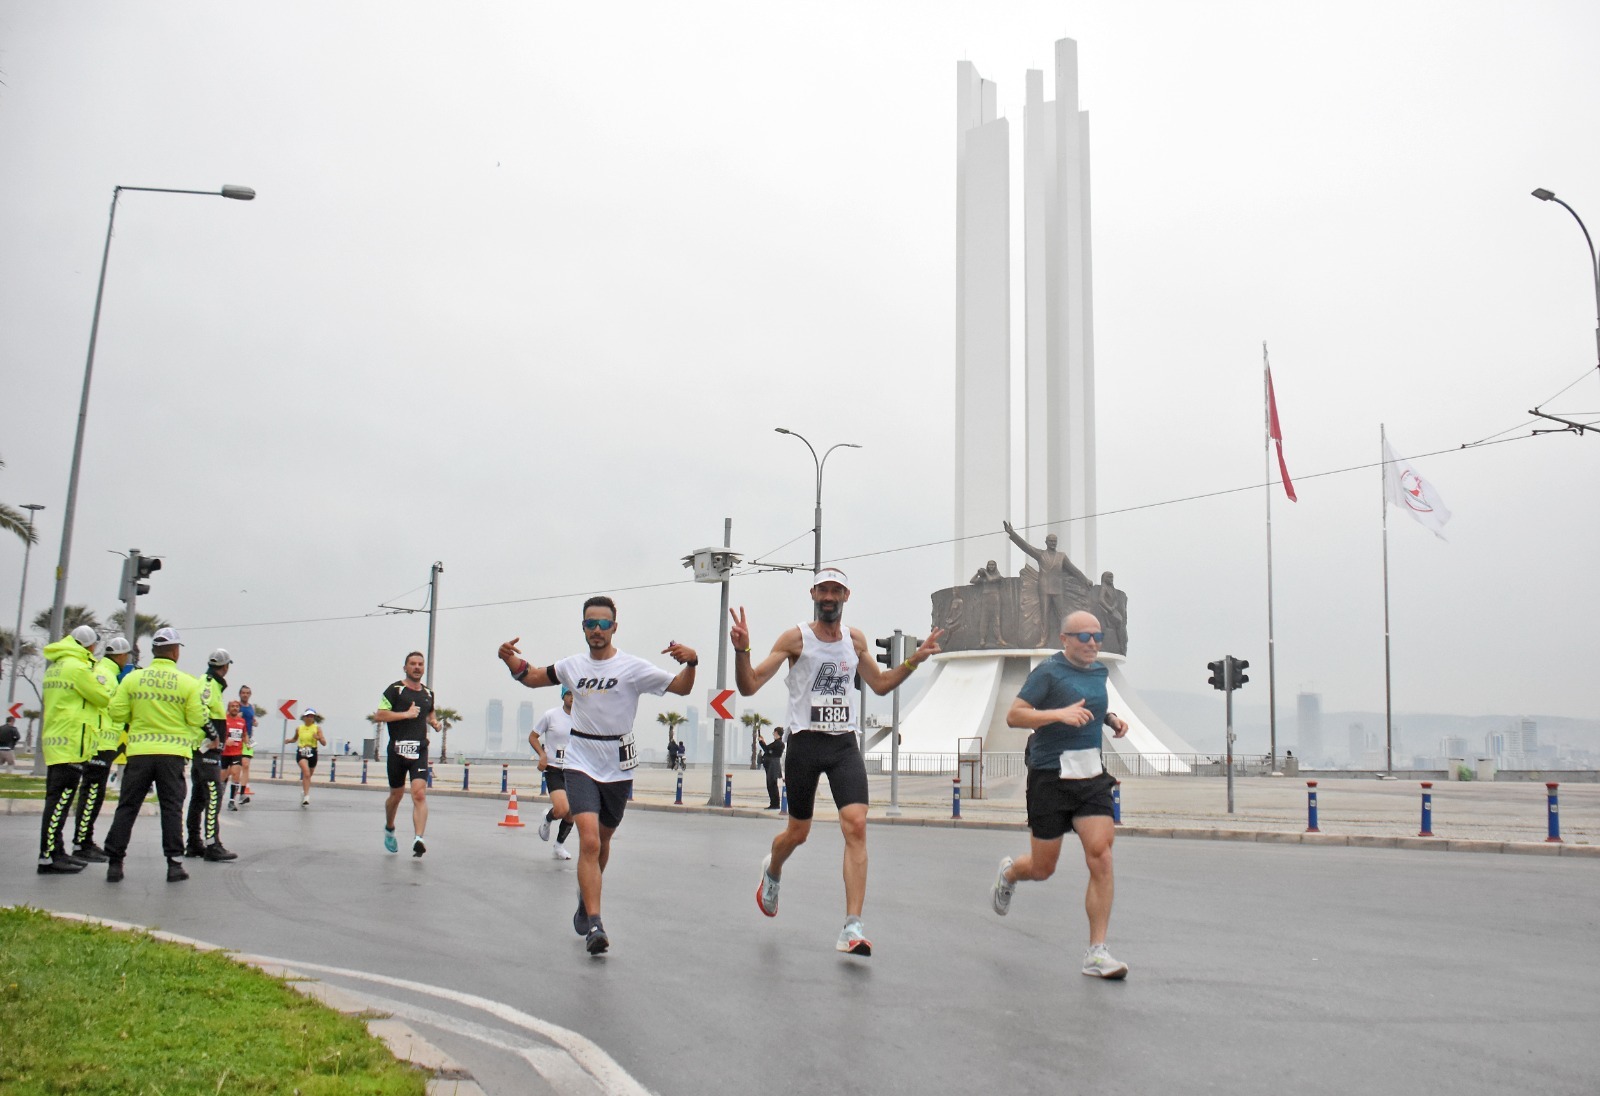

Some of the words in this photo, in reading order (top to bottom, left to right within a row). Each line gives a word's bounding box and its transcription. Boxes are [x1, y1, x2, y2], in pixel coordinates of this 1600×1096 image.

[577, 677, 618, 690] BOLD
[818, 707, 847, 722] 1384
[398, 745, 417, 754] 1052
[624, 744, 636, 760] 10
